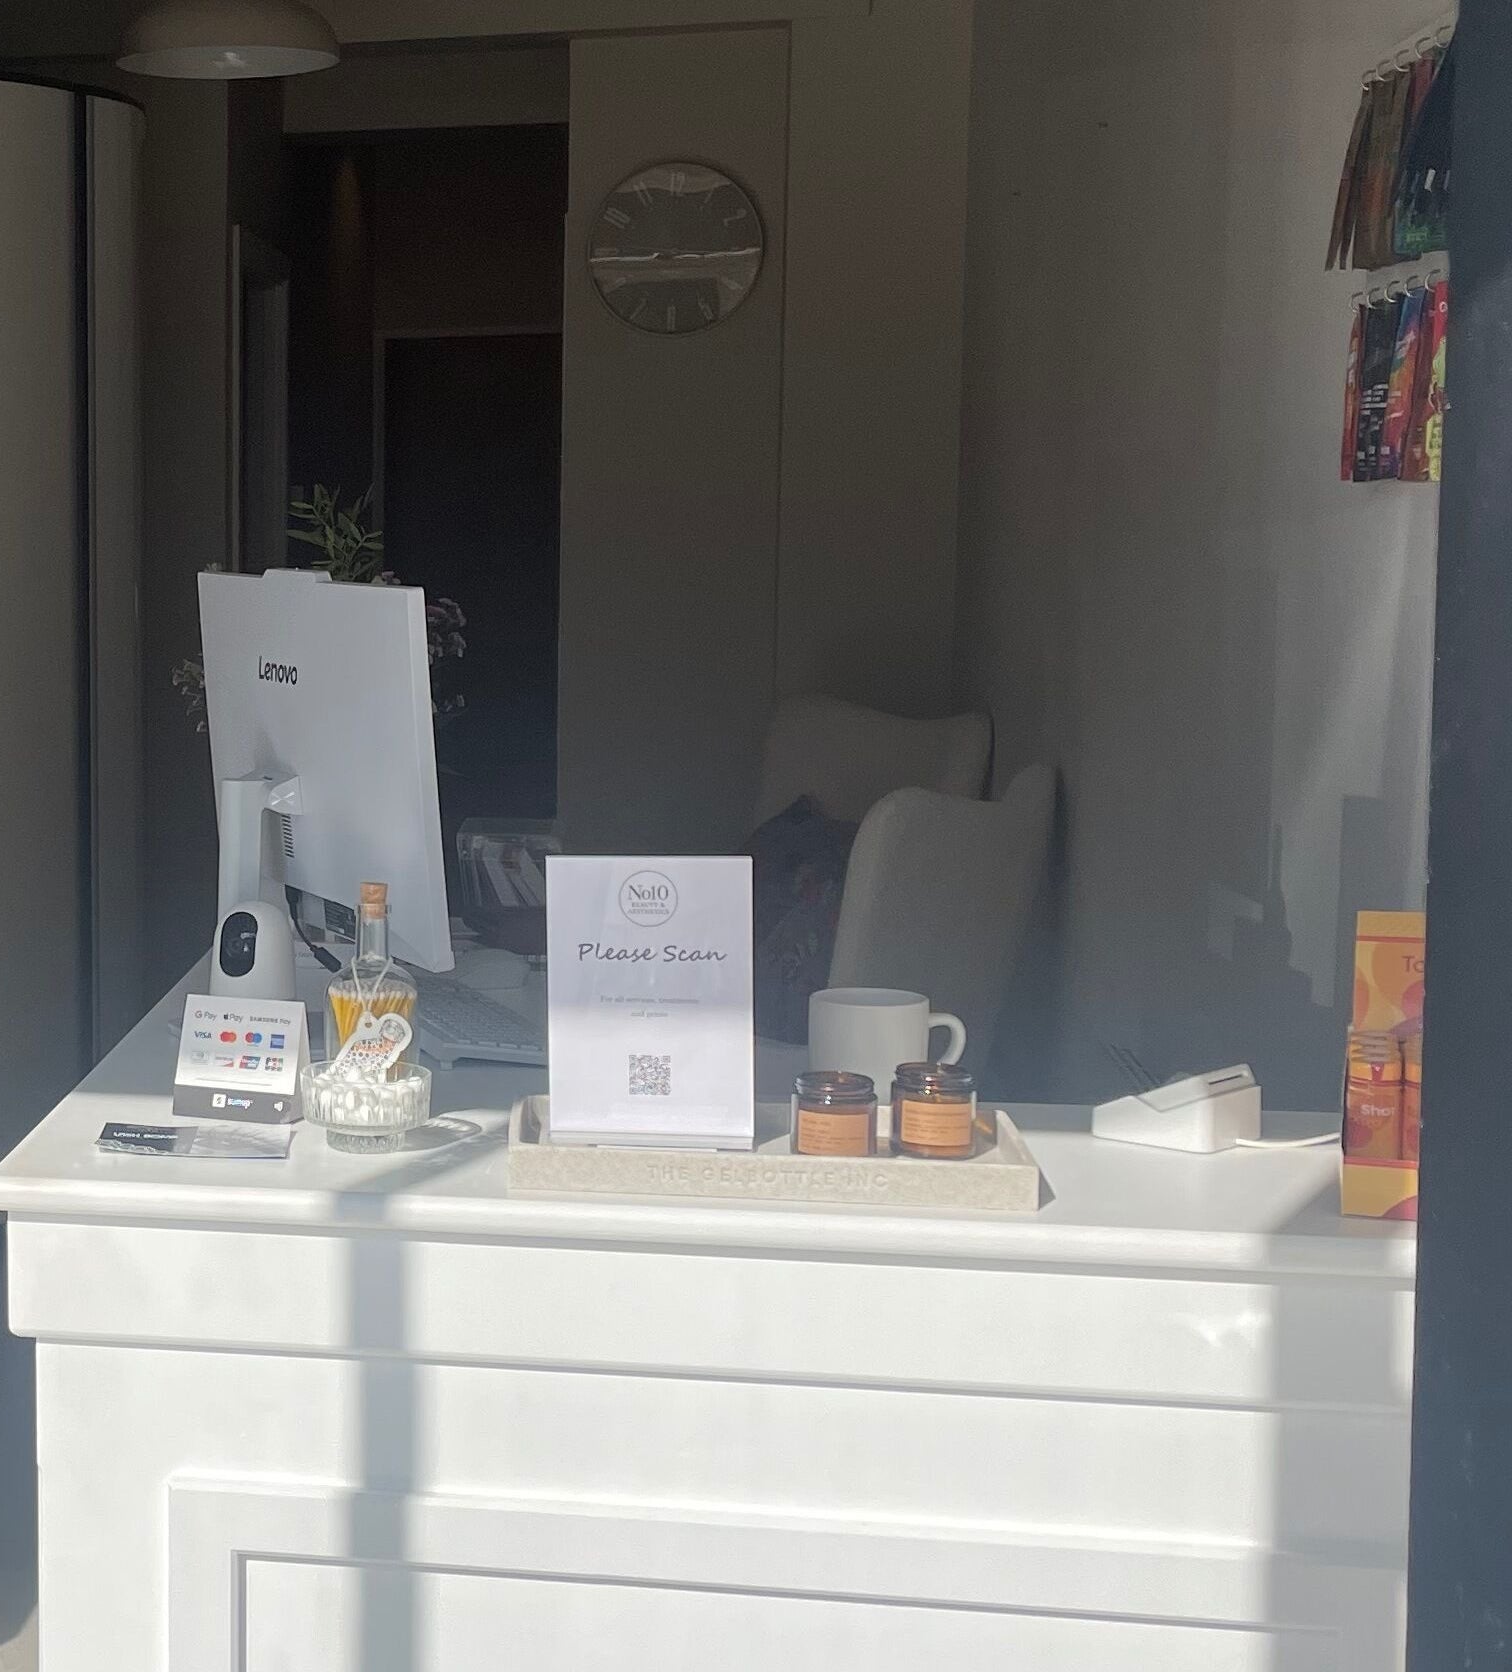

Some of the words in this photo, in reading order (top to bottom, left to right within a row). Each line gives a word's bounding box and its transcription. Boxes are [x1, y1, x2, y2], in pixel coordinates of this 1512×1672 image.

[258, 655, 298, 686] Lenovo
[627, 884, 670, 901] No10
[577, 942, 658, 964] Please
[663, 944, 728, 963] Scan
[229, 1013, 244, 1023] Pay
[194, 1031, 212, 1039] VISA
[646, 1164, 690, 1181] THE
[702, 1166, 836, 1187] GELBOTTLE
[844, 1171, 890, 1189] INC
